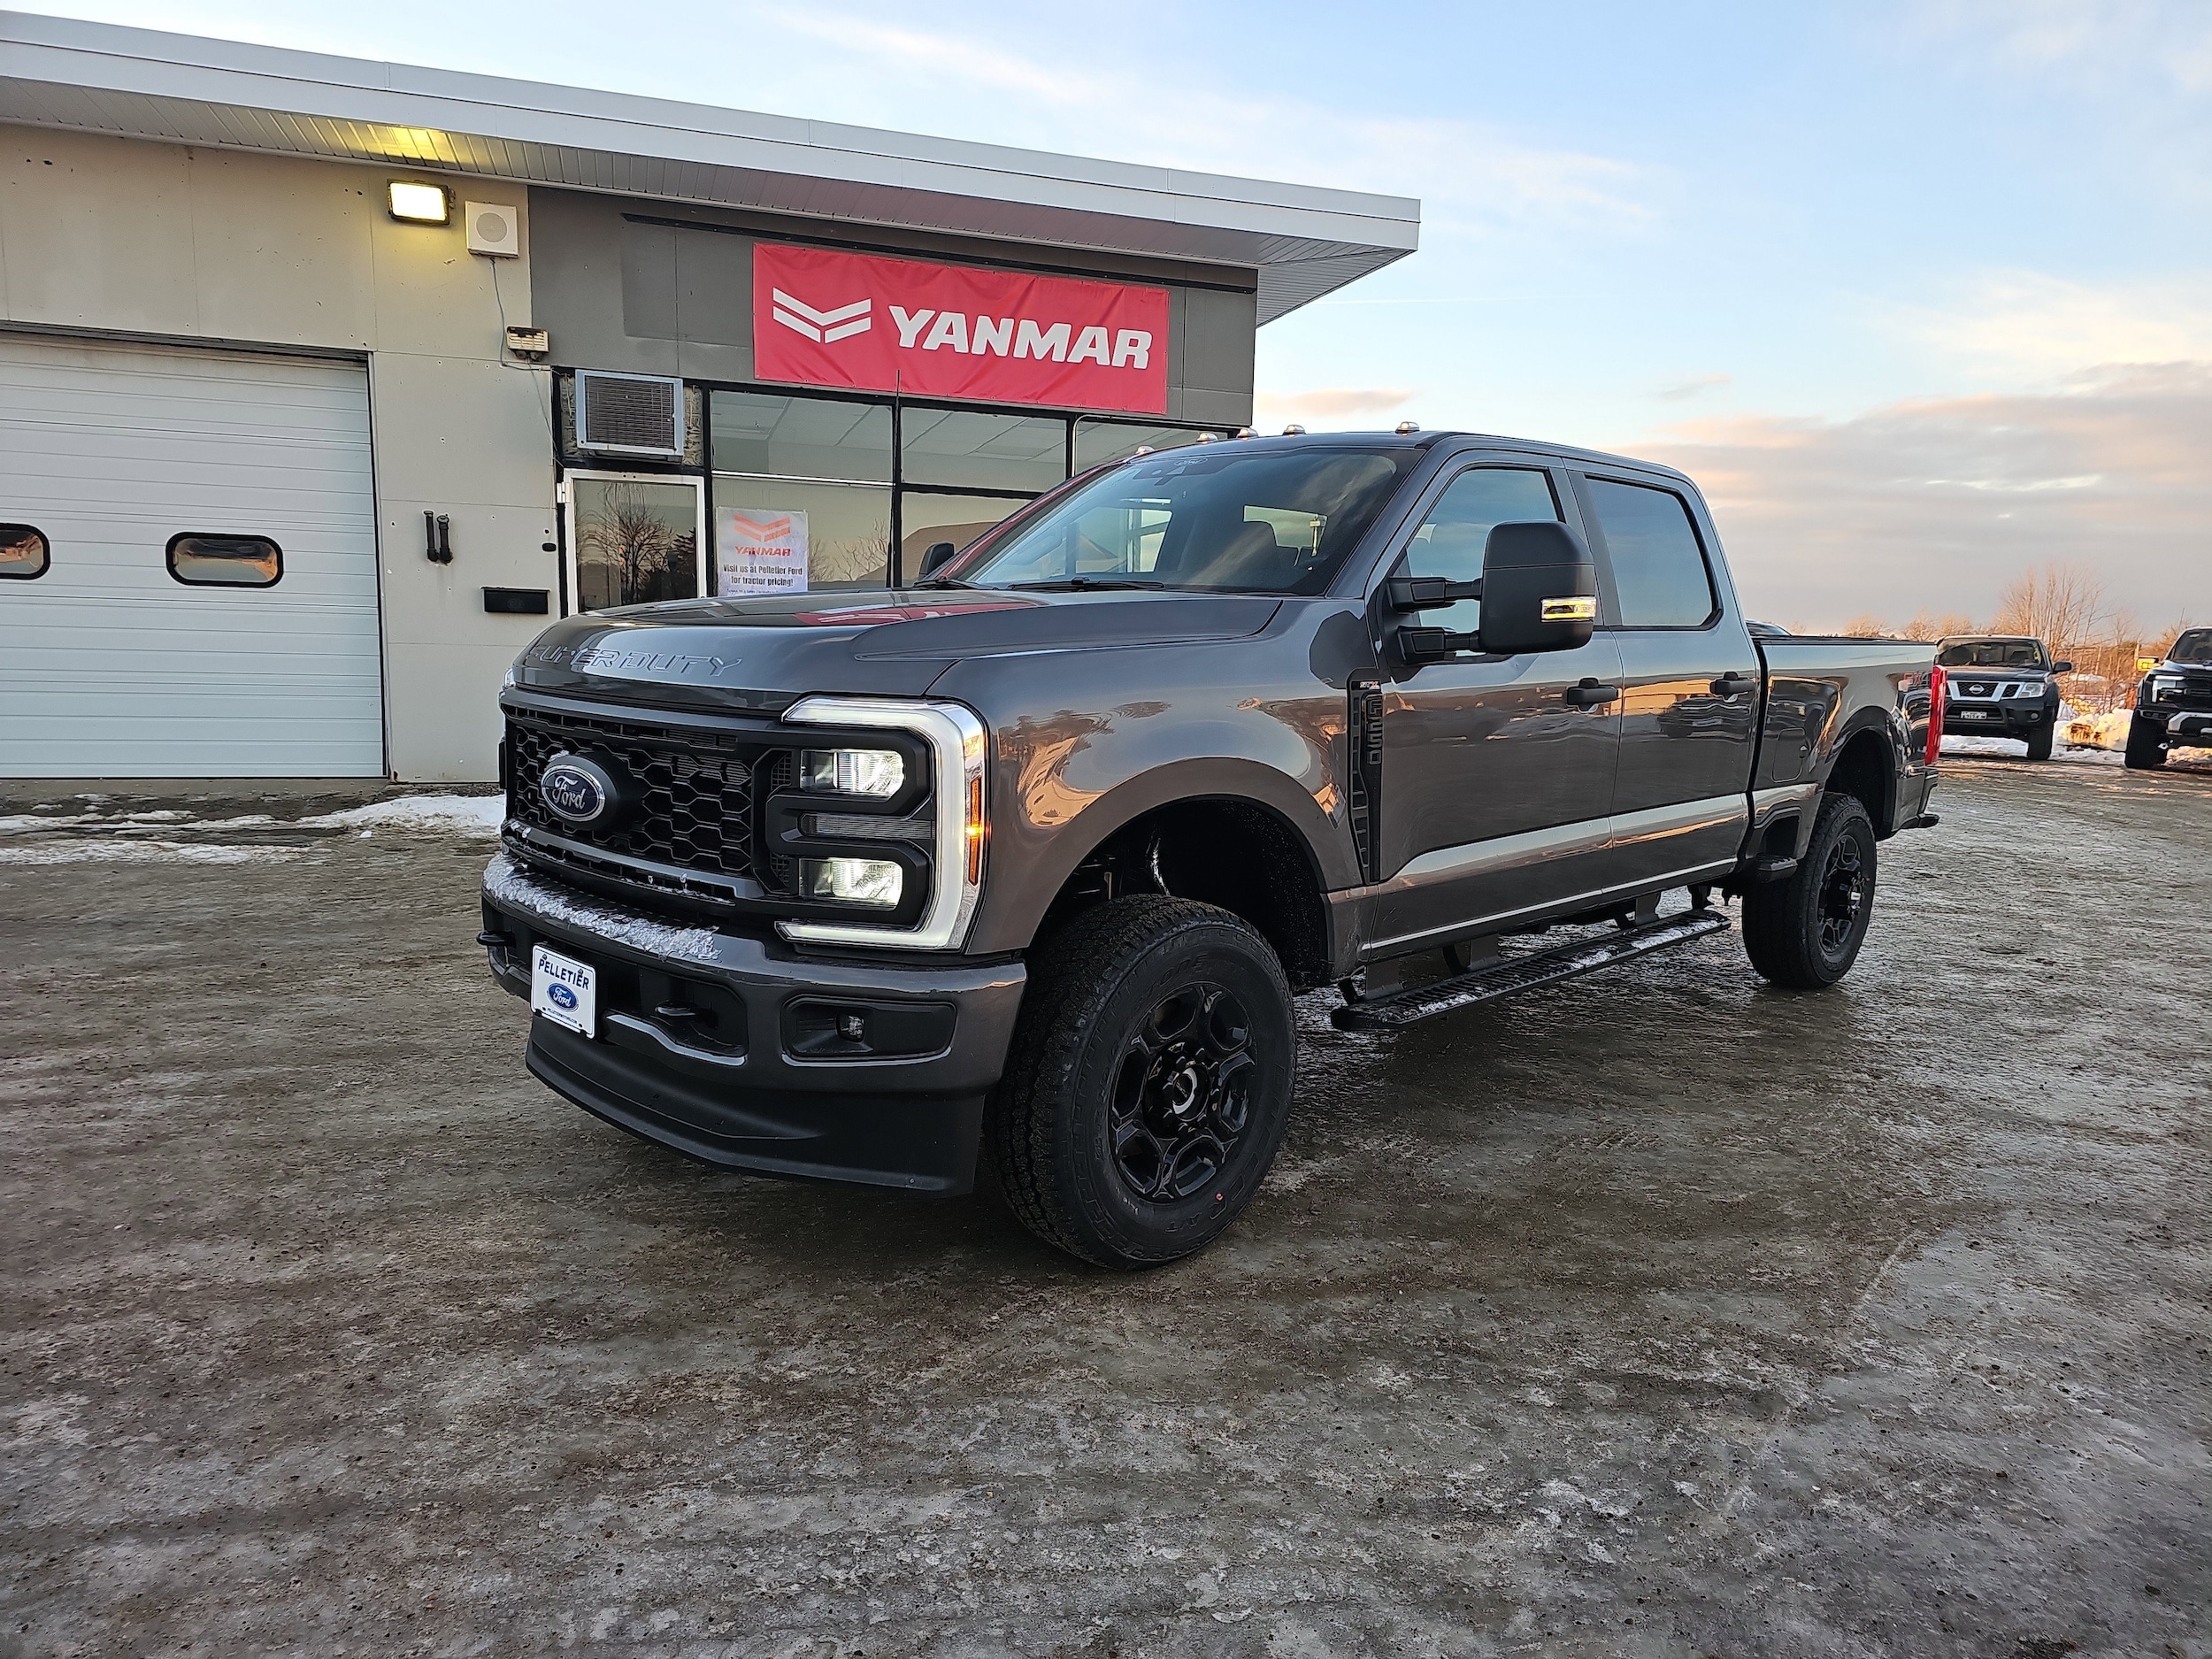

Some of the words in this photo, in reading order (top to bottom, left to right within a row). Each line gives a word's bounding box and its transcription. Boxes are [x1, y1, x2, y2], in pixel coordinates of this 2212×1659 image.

[888, 305, 1152, 369] YANMAR
[734, 546, 791, 556] YANMAR
[723, 564, 738, 573] Visit
[758, 565, 786, 575] Pelletier
[787, 566, 803, 576] Ford
[731, 575, 741, 584] for
[742, 576, 765, 585] tractor
[767, 577, 794, 588] pricing!
[619, 651, 741, 677] DUTY
[1903, 672, 1931, 687] FX4
[551, 775, 587, 810] Ford
[538, 958, 589, 990] PELLETIER
[552, 987, 572, 1007] Ford
